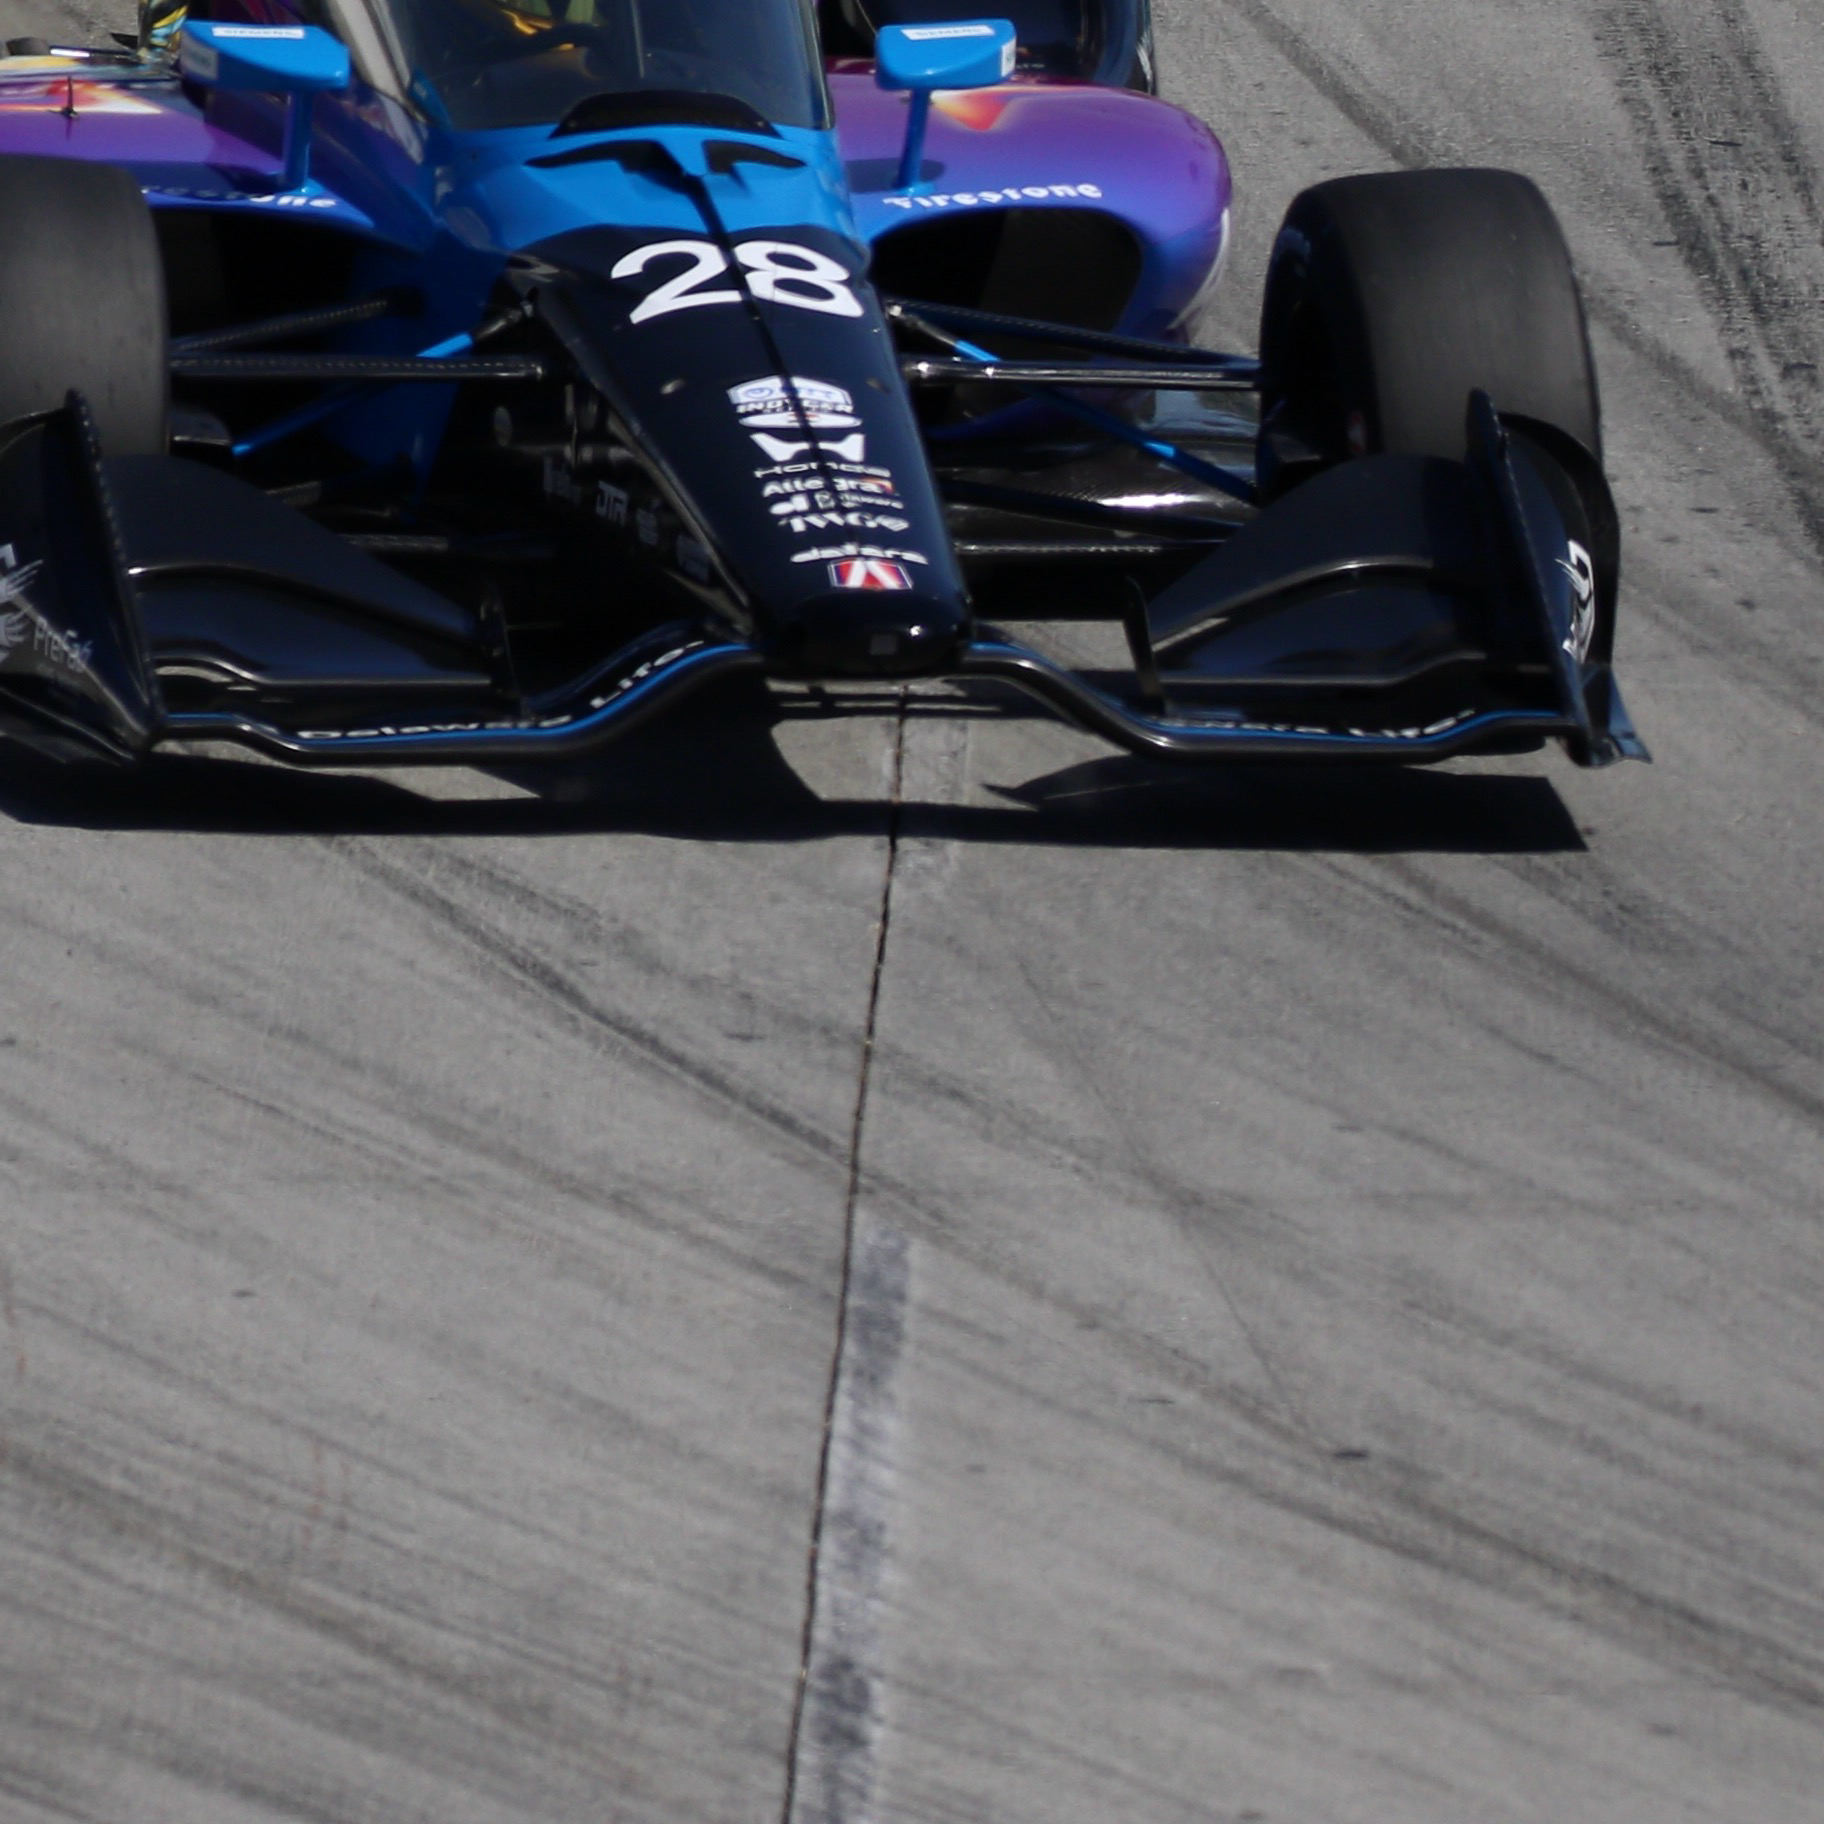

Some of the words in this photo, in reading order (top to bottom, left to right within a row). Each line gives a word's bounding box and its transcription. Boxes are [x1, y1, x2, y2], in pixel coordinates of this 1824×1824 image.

[882, 182, 1103, 210] Firestone
[609, 238, 865, 325] 28
[736, 397, 854, 414] INDYCAR
[753, 461, 892, 478] Honda
[789, 541, 929, 565] dallara
